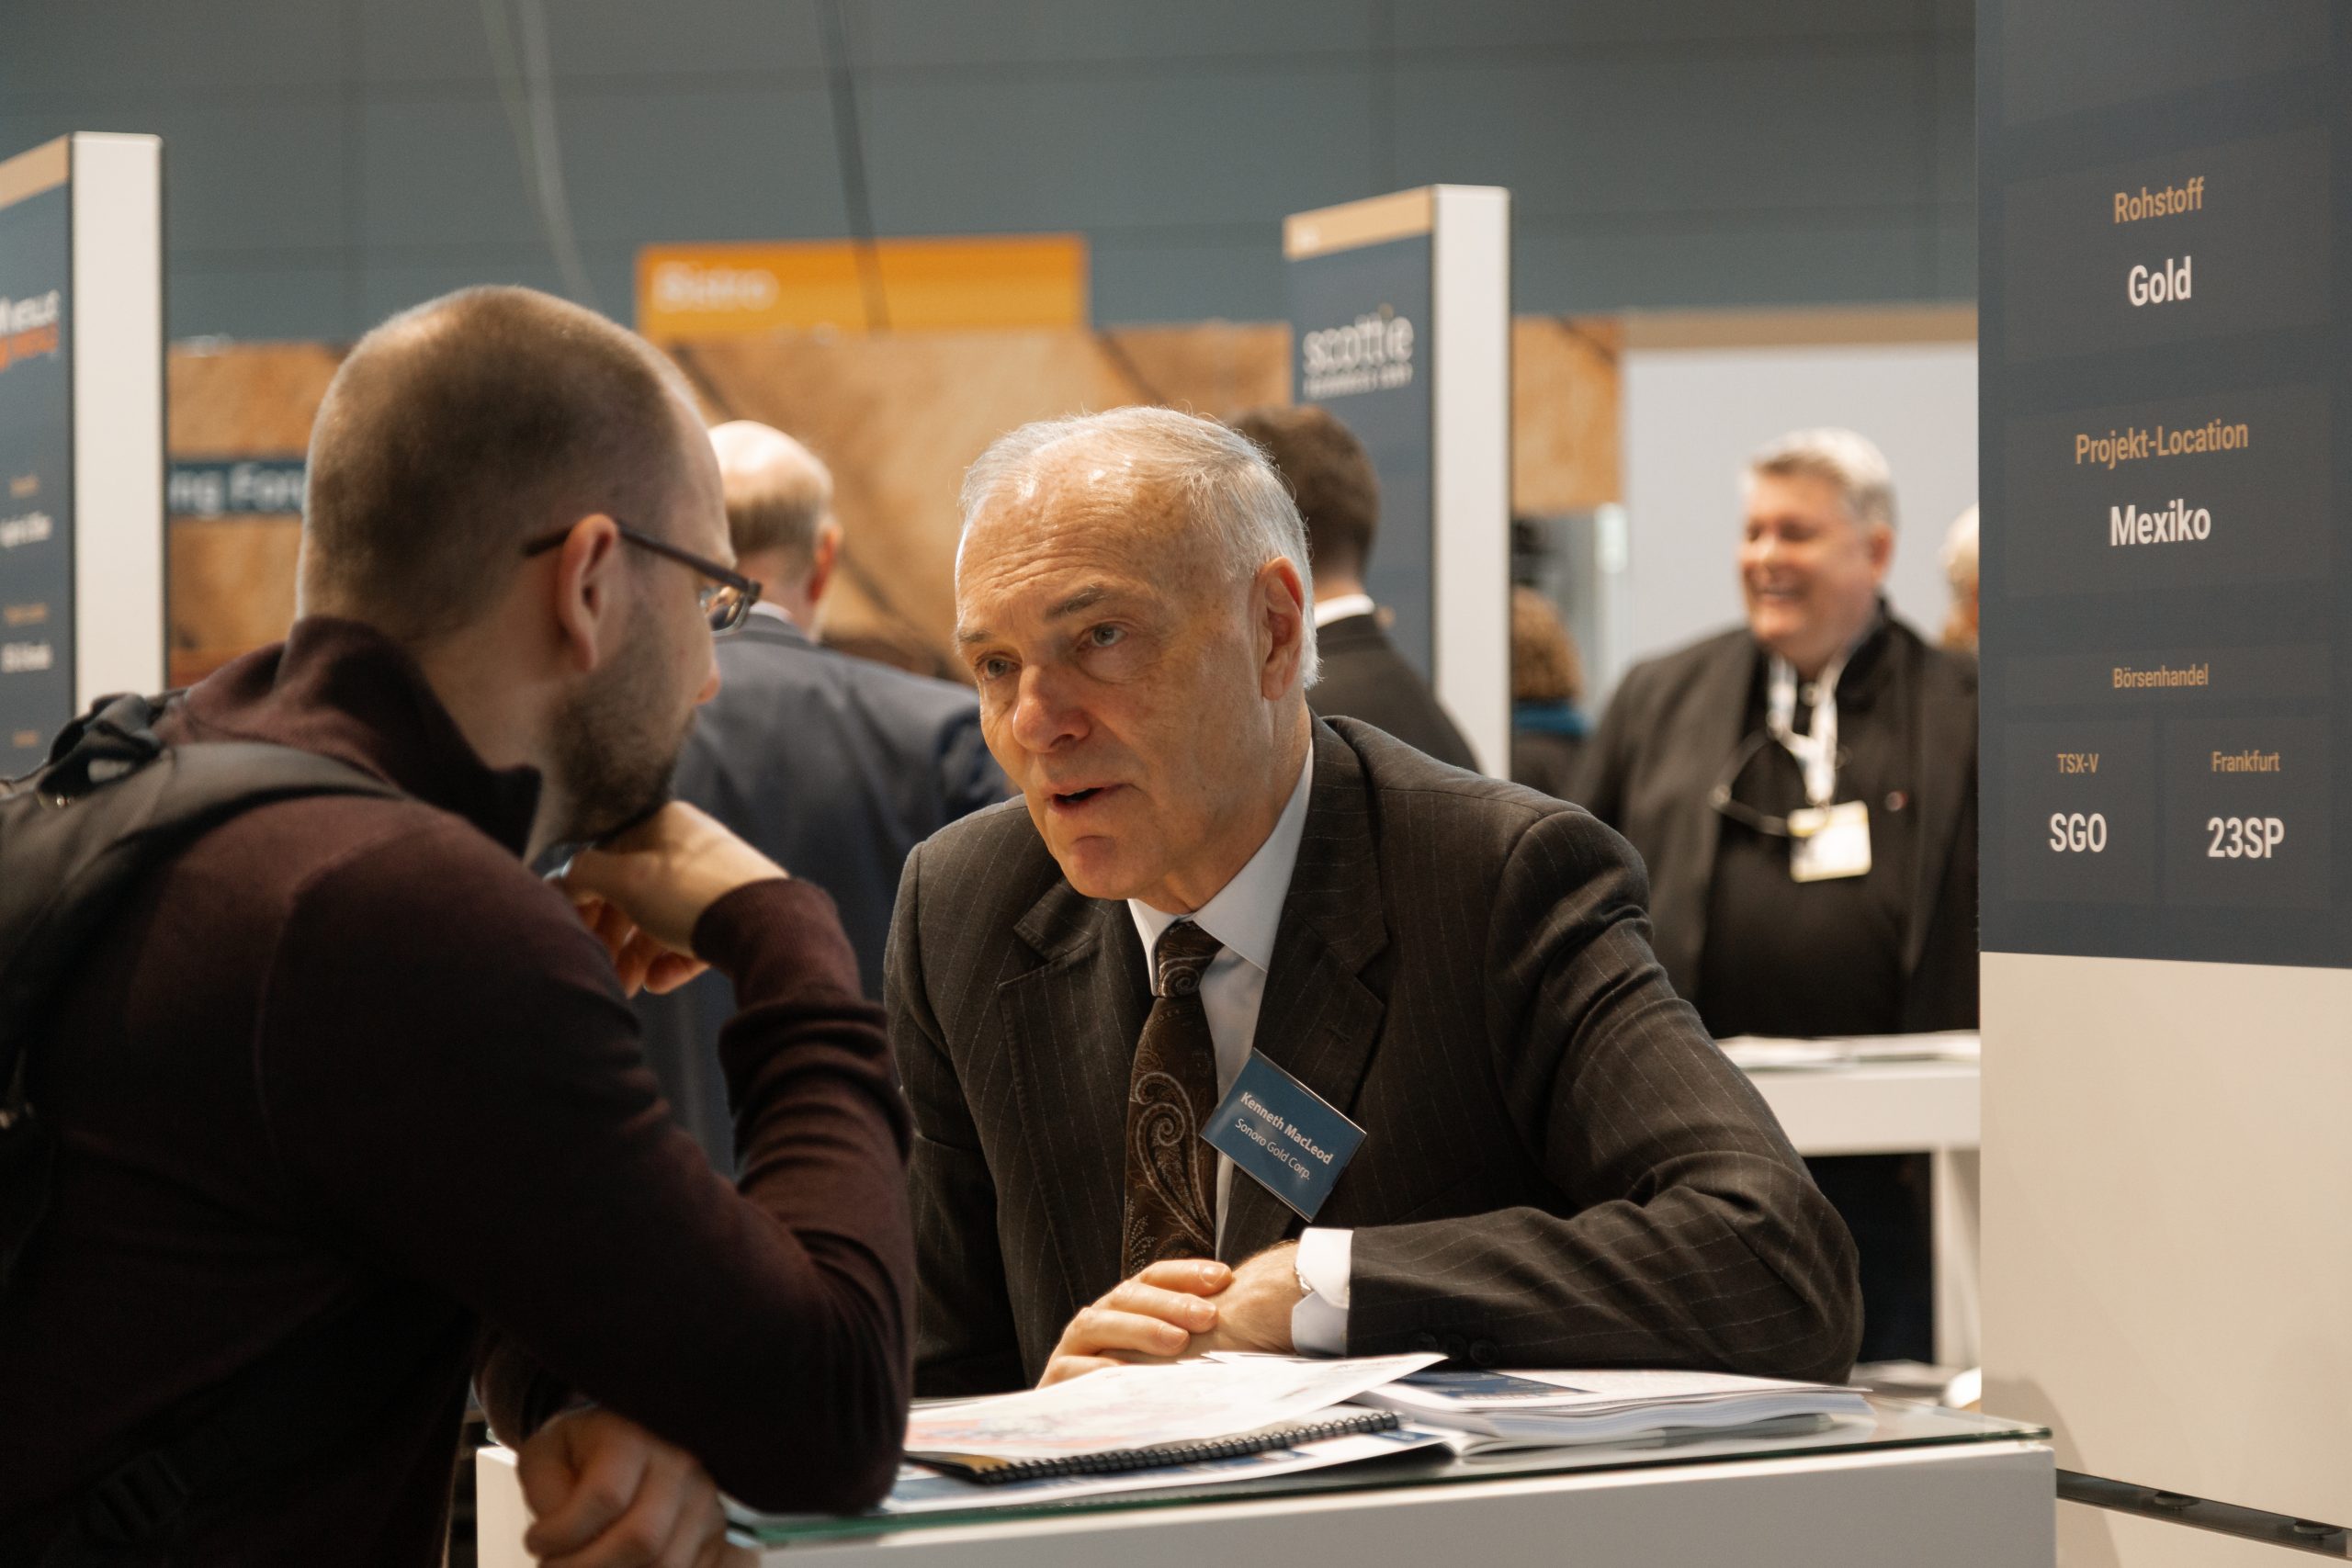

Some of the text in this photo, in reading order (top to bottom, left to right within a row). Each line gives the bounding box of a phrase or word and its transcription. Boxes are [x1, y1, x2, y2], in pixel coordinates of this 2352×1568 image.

[2113, 175, 2204, 223] Rohstoff
[2128, 255, 2192, 307] Gold
[2075, 417, 2249, 470] Projekt-Location
[2110, 498, 2211, 547] Mexiko
[2112, 663, 2210, 689] Börsenhandel
[2057, 751, 2099, 774] TSX-V
[2211, 749, 2280, 773] Frankfurt
[2049, 812, 2108, 853] SGO
[2207, 817, 2285, 859] 23SP
[1235, 1118, 1310, 1181] Sonoro Gold Corp.
[1239, 1091, 1334, 1166] Kenneth MacLeod
